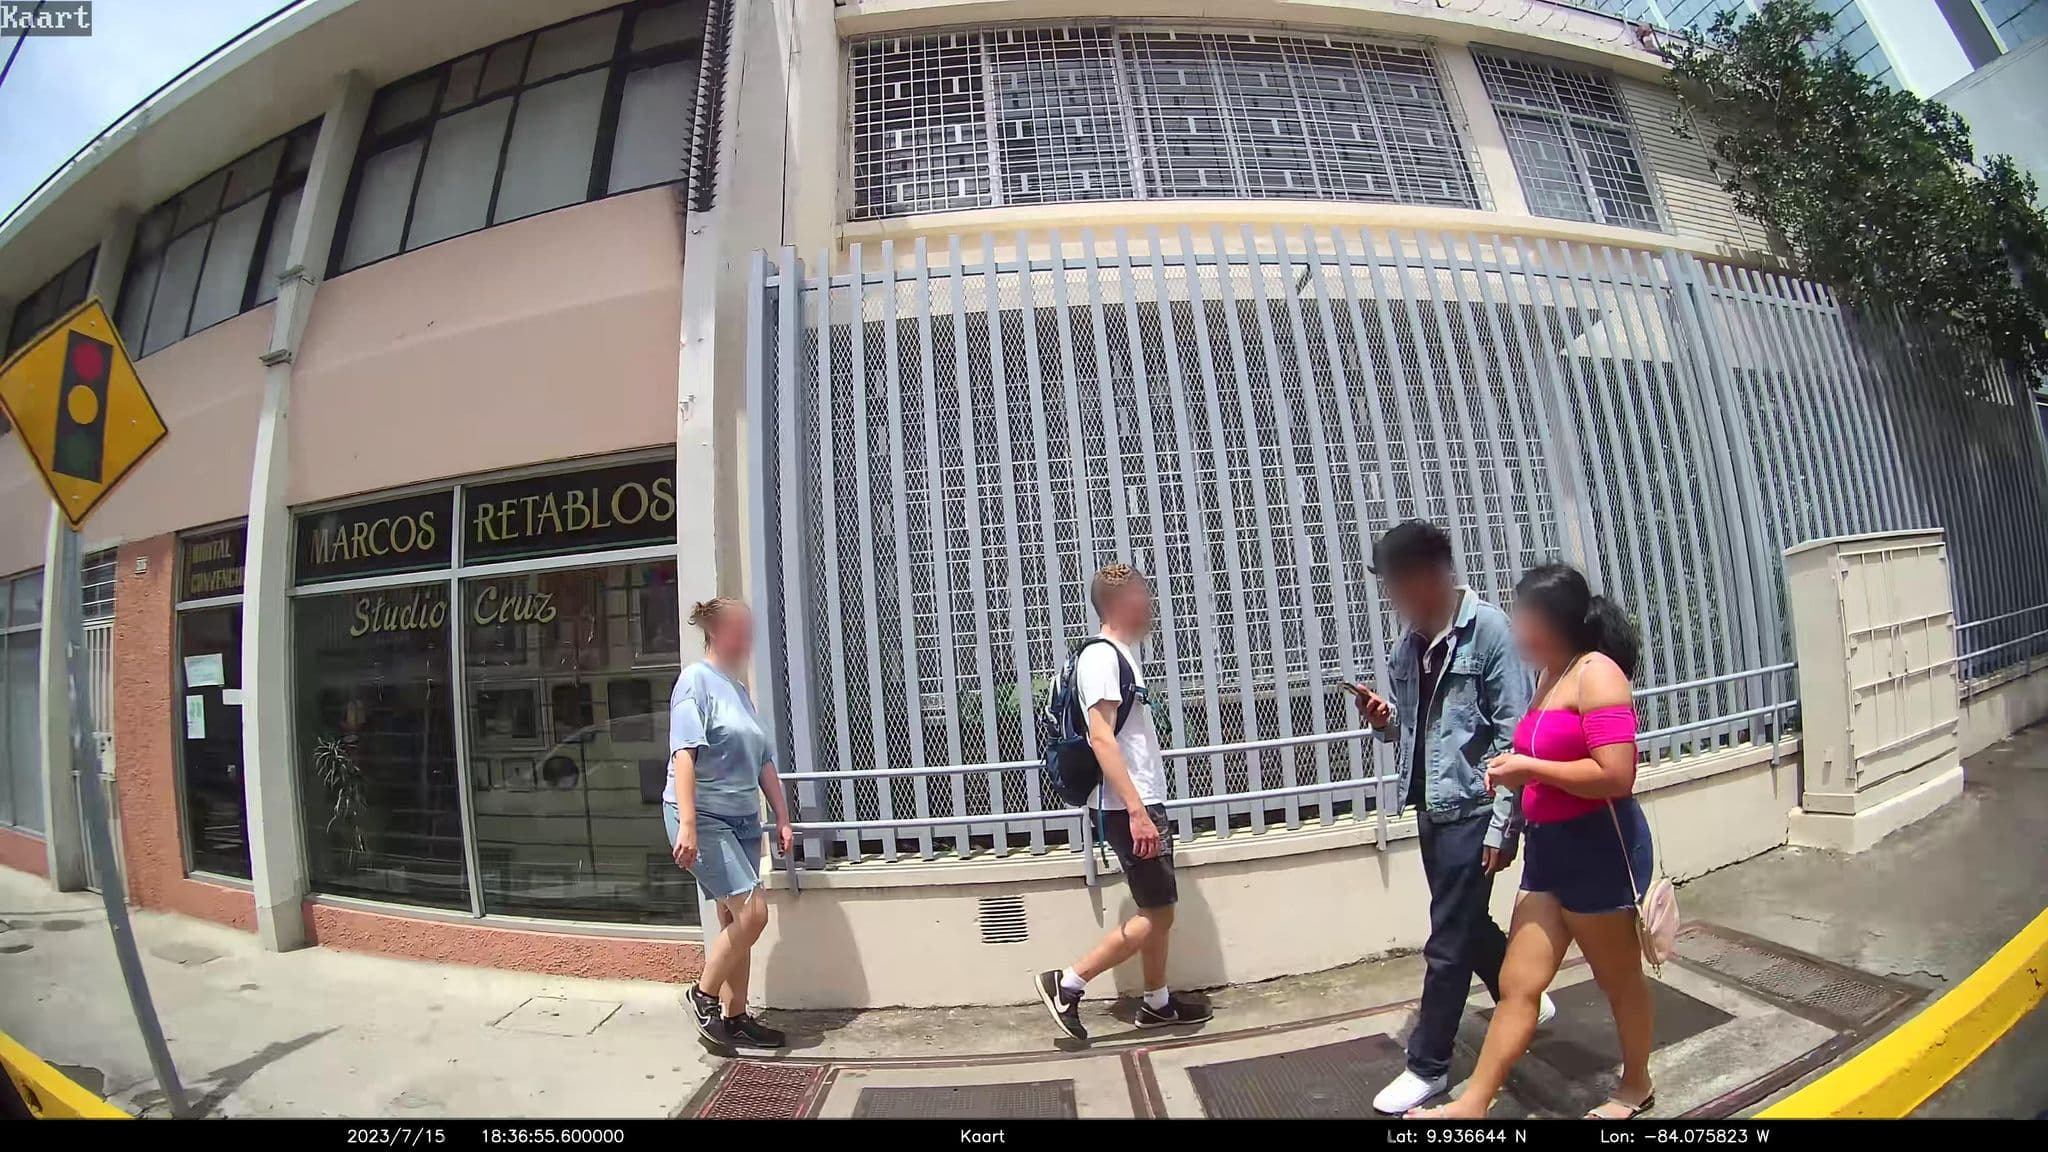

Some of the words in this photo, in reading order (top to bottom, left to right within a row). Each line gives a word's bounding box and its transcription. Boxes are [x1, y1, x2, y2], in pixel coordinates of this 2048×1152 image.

[309, 510, 436, 565] MARCOS
[473, 477, 676, 543] RETABLOS
[350, 589, 448, 638] Studio
[473, 585, 558, 626] Cruz
